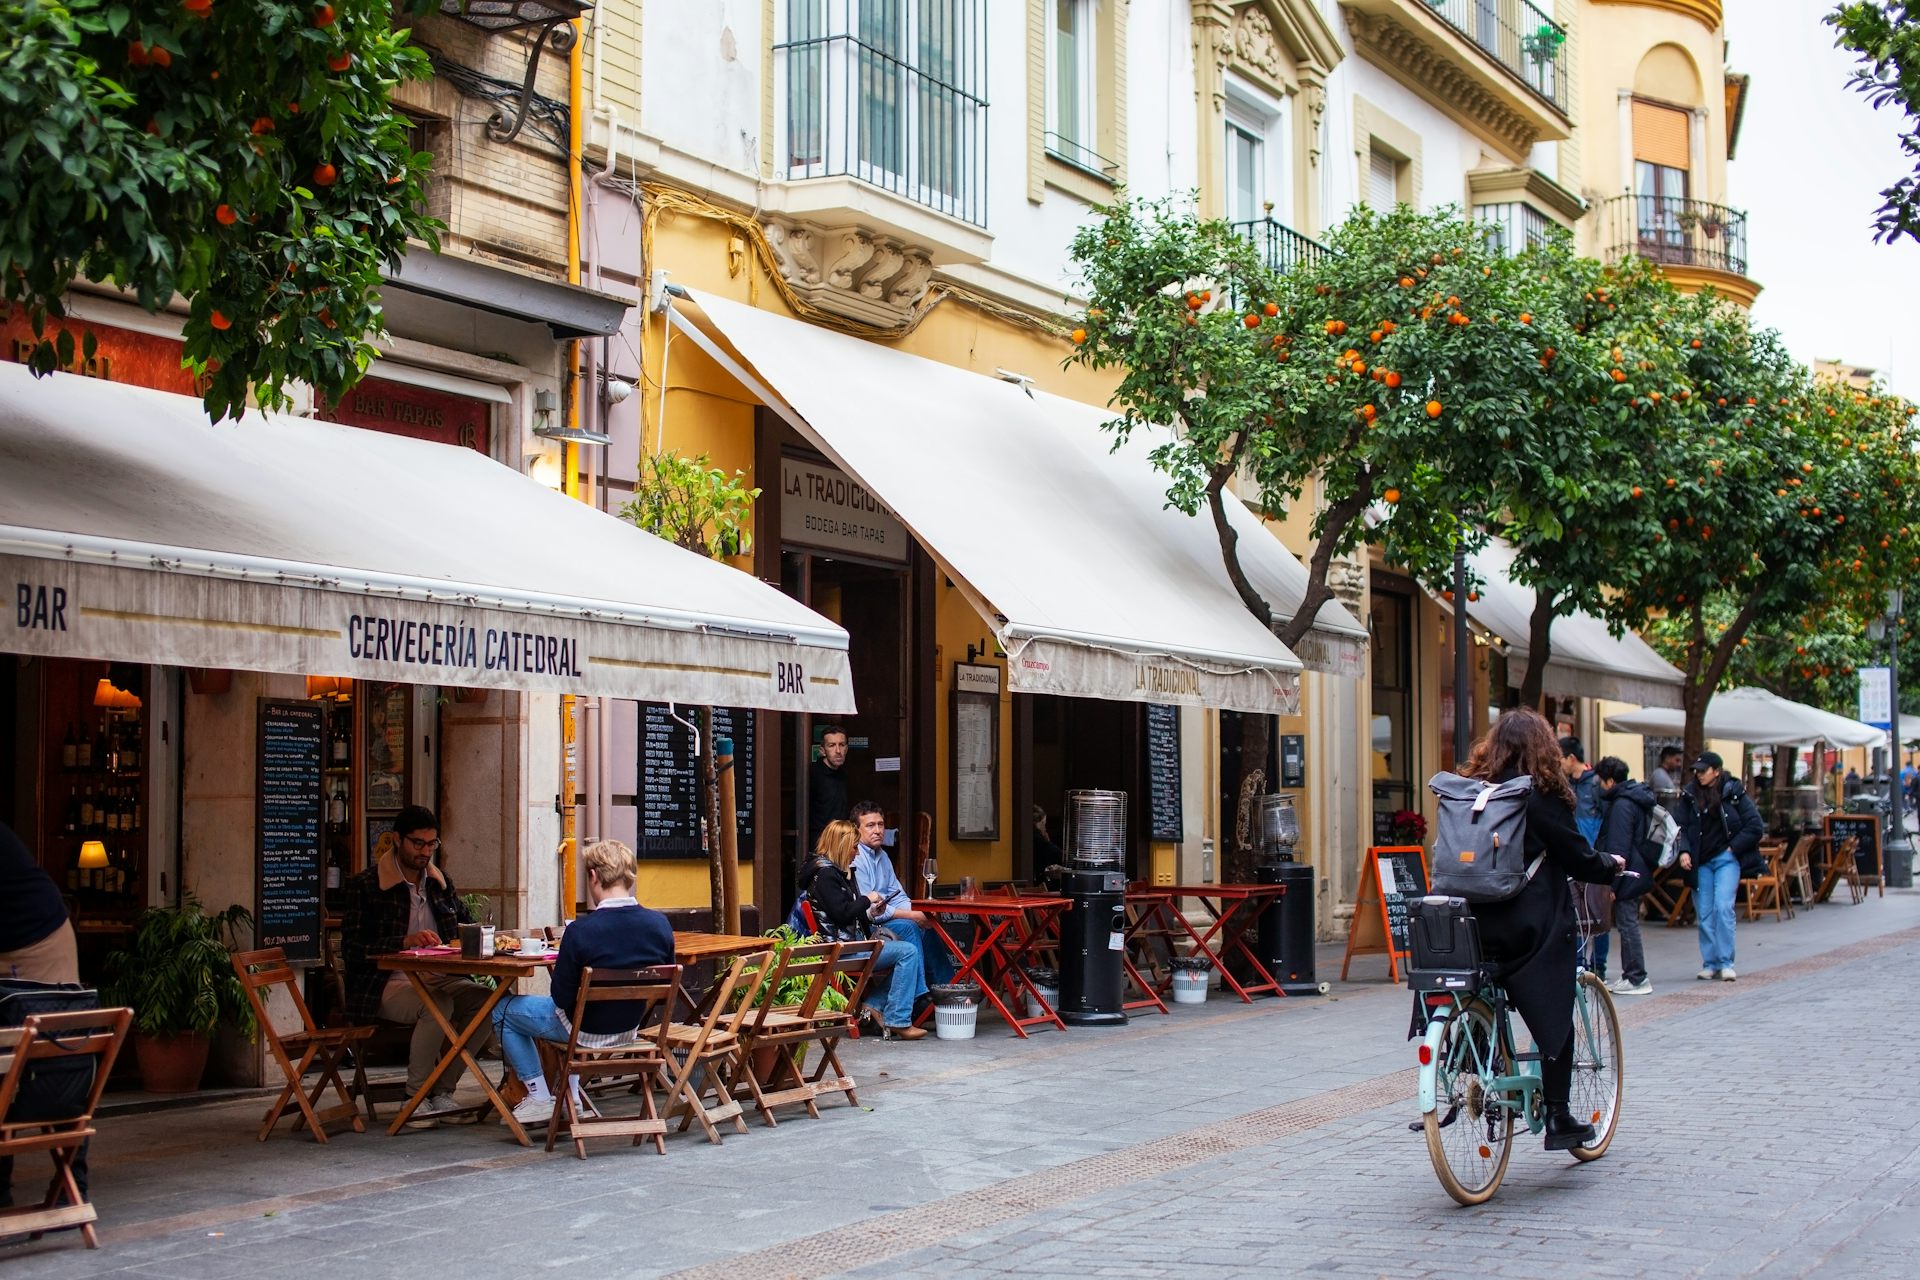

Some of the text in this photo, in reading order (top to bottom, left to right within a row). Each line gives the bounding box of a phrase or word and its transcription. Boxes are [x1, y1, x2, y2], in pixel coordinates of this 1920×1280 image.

[354, 396, 386, 417] BAR
[392, 402, 445, 429] TAPAS
[784, 467, 802, 497] LA
[805, 515, 885, 544] BODEGA BAR TAPAS
[16, 583, 67, 632] BAR
[349, 614, 582, 678] CERVECERÍA CATEDRAL
[777, 661, 805, 695] BAR
[959, 672, 998, 684] LA TRADICIONAL
[1022, 657, 1050, 671] Cruzcampo
[1135, 664, 1202, 697] LA TRADICIONAL
